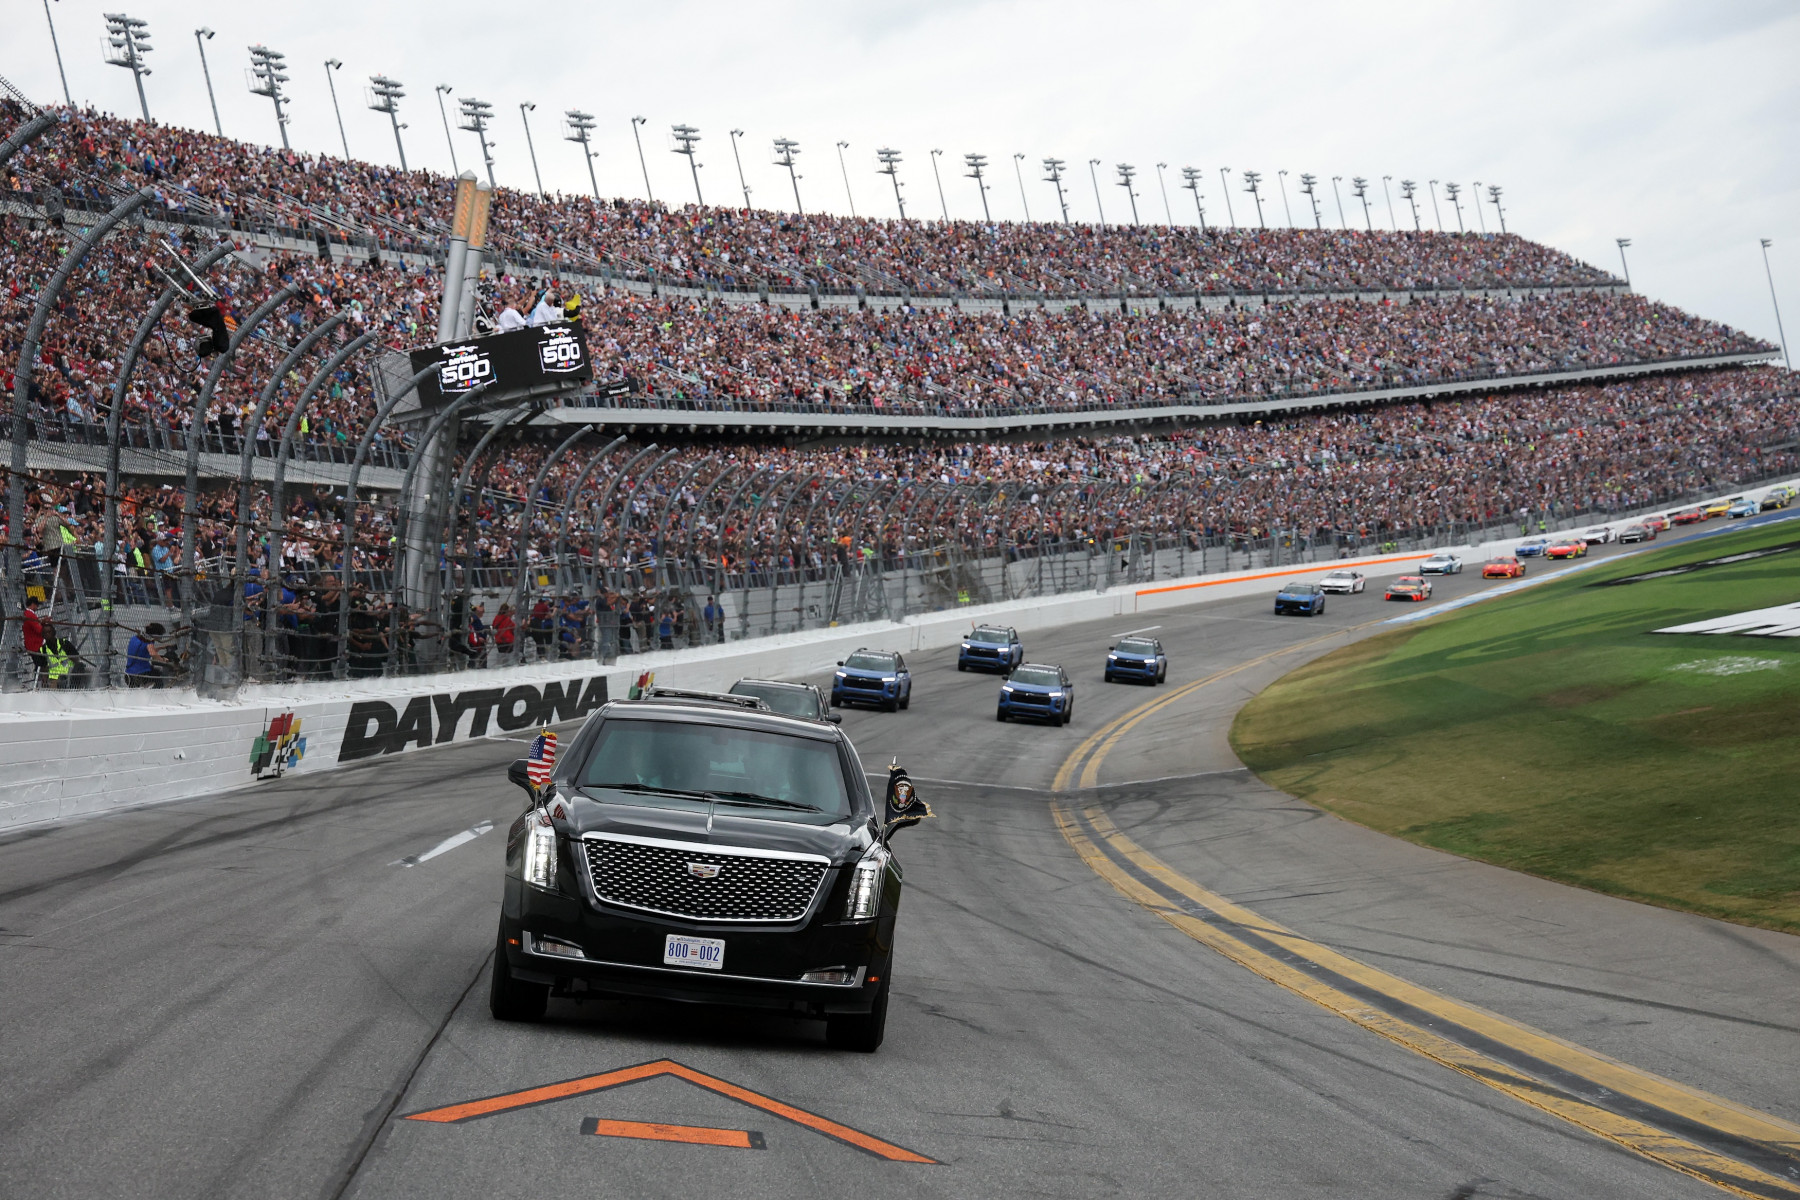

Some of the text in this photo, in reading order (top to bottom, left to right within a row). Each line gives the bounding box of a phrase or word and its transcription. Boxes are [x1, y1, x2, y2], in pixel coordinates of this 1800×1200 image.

[542, 343, 580, 363] 500
[441, 359, 490, 384] 500
[338, 676, 608, 762] DAYTONA
[668, 942, 720, 962] 800 002
